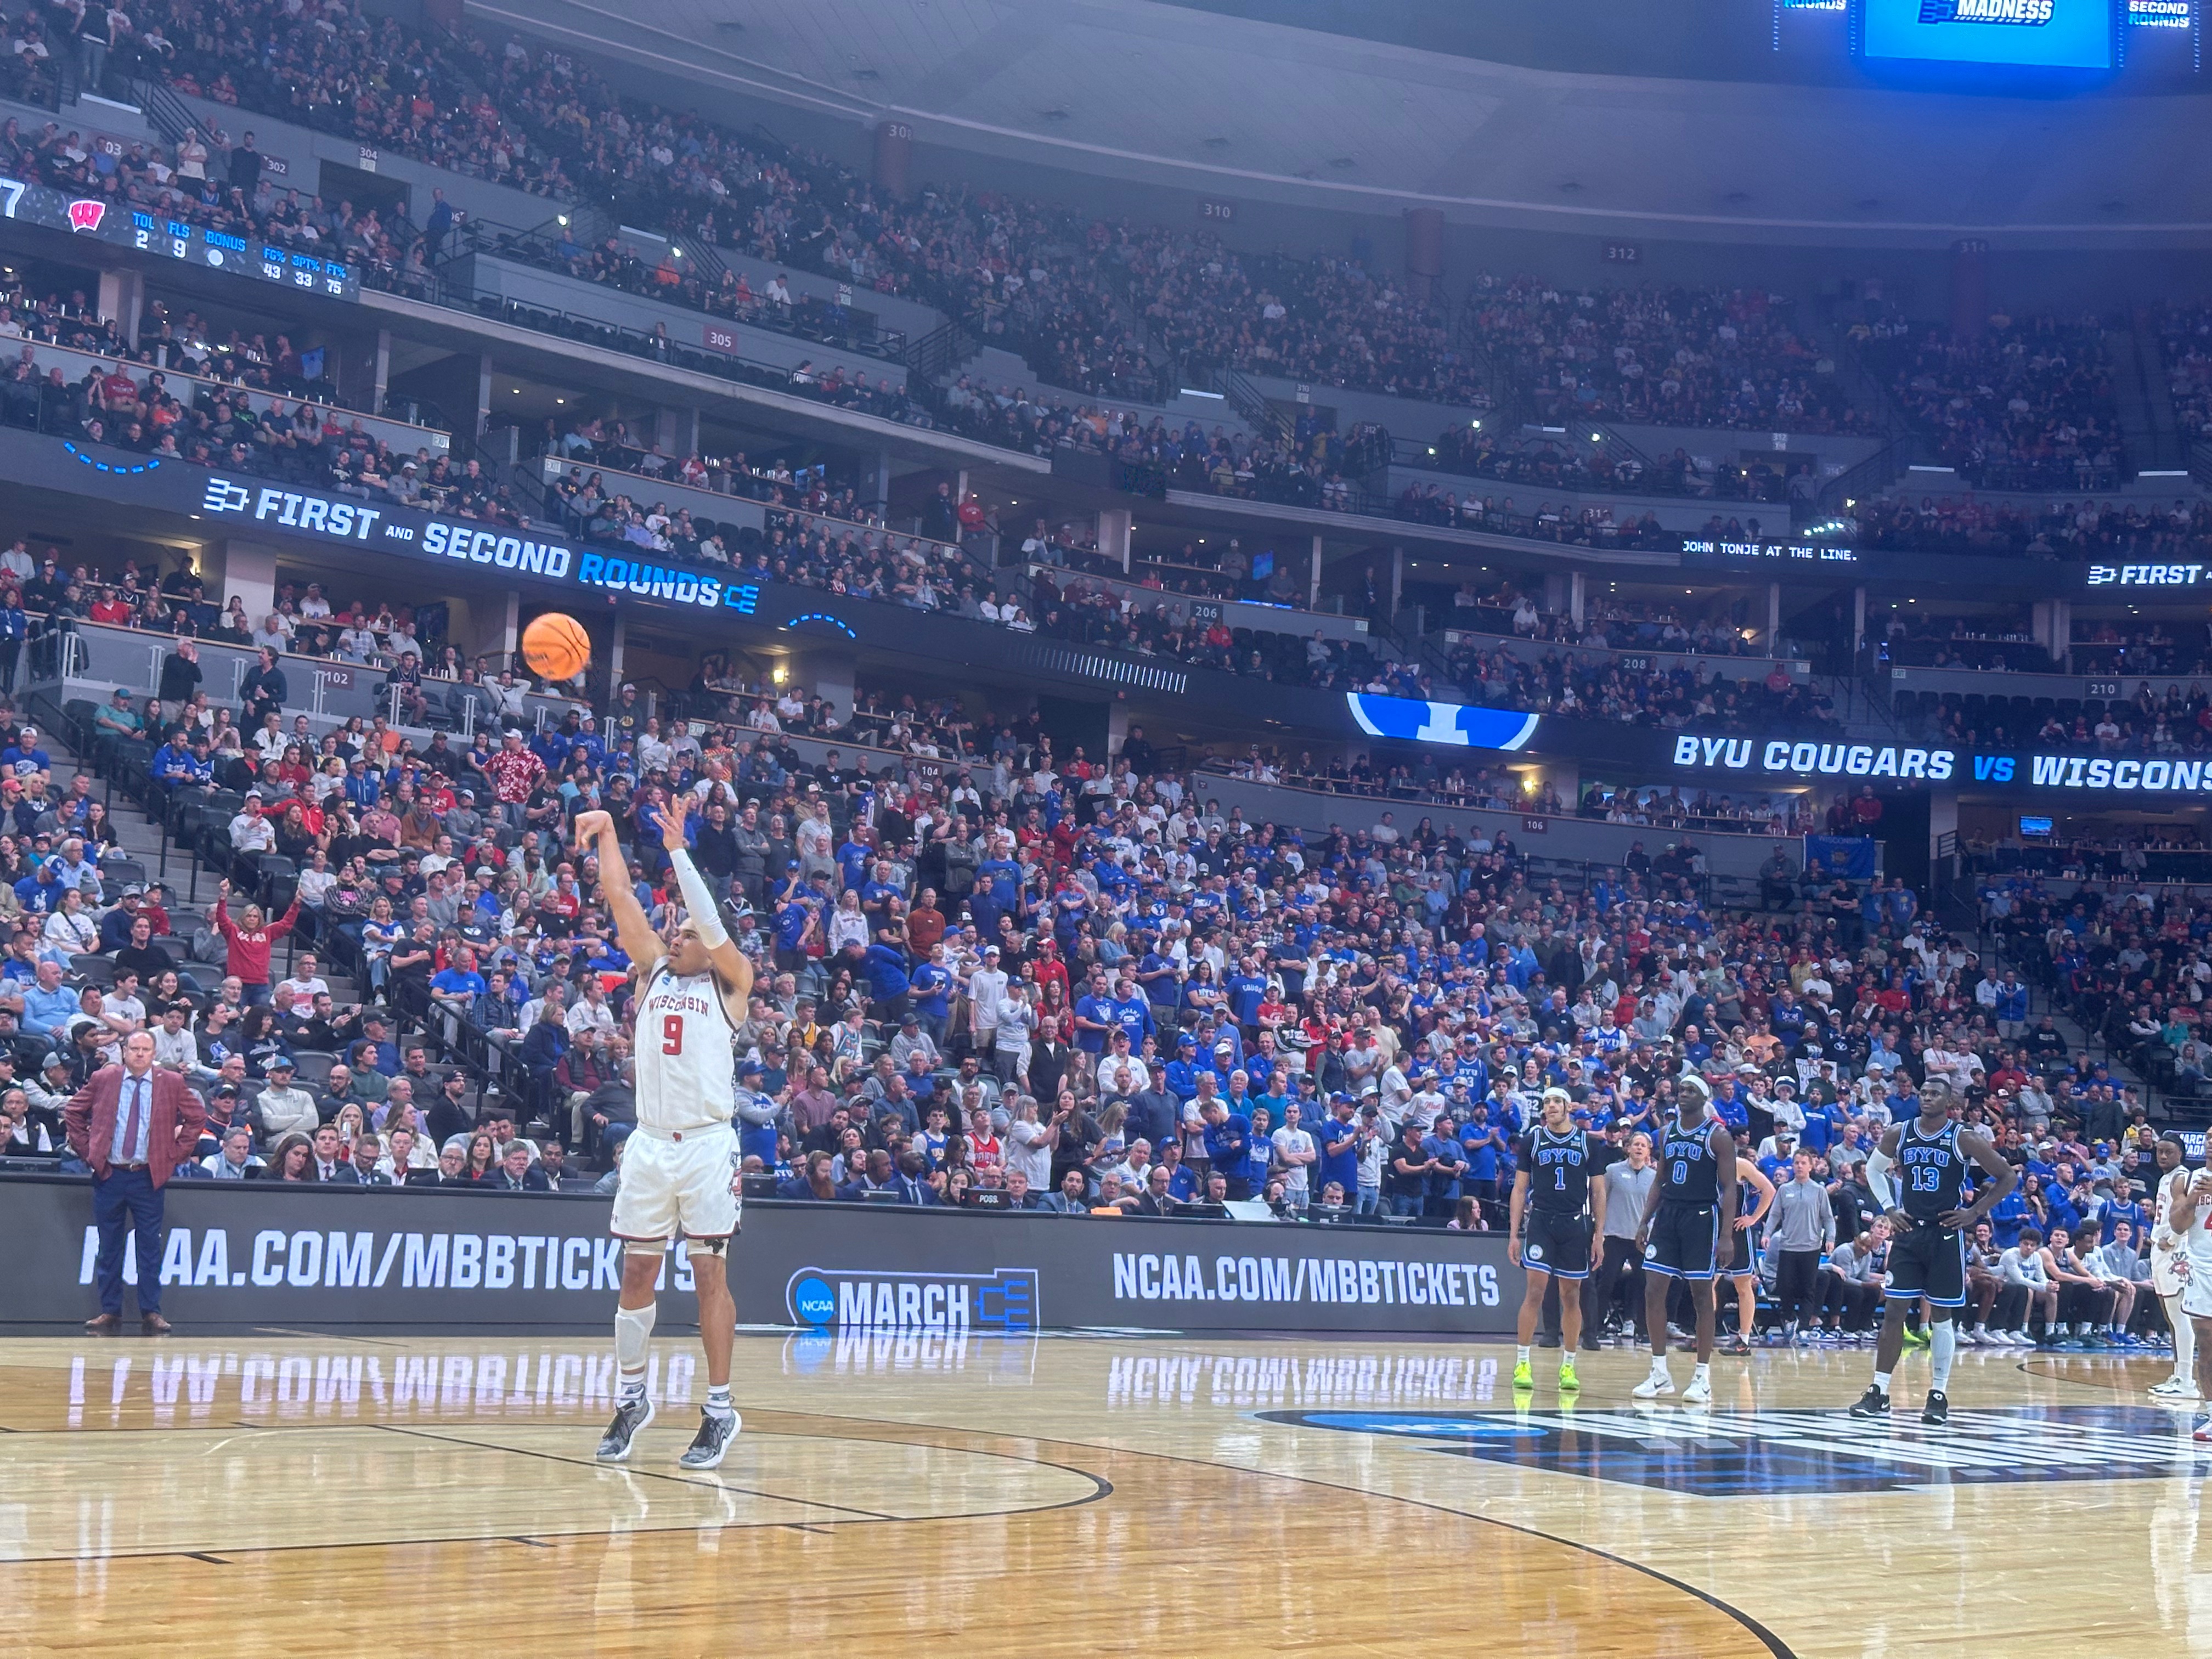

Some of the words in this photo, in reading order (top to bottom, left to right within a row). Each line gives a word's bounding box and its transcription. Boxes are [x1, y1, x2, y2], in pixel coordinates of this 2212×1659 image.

[1957, 0, 2053, 20] MADNESS
[2129, 1, 2188, 15] SECOND
[2129, 14, 2191, 28] ROUNDS
[105, 142, 121, 155] 03
[360, 147, 377, 160] 304
[268, 160, 286, 173] 302
[0, 178, 25, 218] 7
[1205, 204, 1229, 218] 310
[133, 212, 154, 230] TOL
[168, 221, 190, 239] FLS
[136, 230, 148, 249] 2
[173, 239, 187, 258] 9
[205, 229, 246, 252] BONUS
[263, 246, 286, 263] FG%
[291, 253, 320, 272] 3PT%
[326, 262, 347, 278] FT%
[1609, 247, 1634, 259] 312
[263, 263, 281, 280] 43
[295, 271, 313, 287] 33
[326, 278, 342, 295] 75
[839, 284, 852, 295] 306
[710, 332, 731, 348] 305
[1364, 425, 1376, 434] 312
[255, 487, 381, 540] FIRST
[385, 524, 414, 541] AND
[422, 521, 571, 579] SECOND
[578, 552, 722, 607] ROUNDS
[1682, 541, 1714, 553] JOHN
[1720, 543, 1759, 556] TONJE
[1765, 546, 1782, 557] AT
[1788, 547, 1813, 558] THE
[1820, 549, 1858, 561] LINE.
[2119, 565, 2203, 585] FIRST
[1196, 606, 1217, 618] 206
[1624, 658, 1646, 669] 208
[326, 671, 348, 685] 102
[2091, 684, 2115, 695] 210
[690, 724, 704, 735] EXIT
[1673, 735, 1752, 769] BYU
[1763, 741, 1955, 780] COUGARS
[1974, 755, 2015, 782] VS
[922, 766, 938, 776] 104
[1527, 821, 1543, 830] 106
[1818, 835, 1863, 844] WISCONSIN
[648, 995, 709, 1017] WISCONSIN
[662, 1014, 684, 1056] 9
[1458, 1068, 1478, 1076] BYU
[1538, 1148, 1582, 1166] BYU
[1665, 1141, 1703, 1161] BYU
[1903, 1146, 1950, 1167] BYU
[1555, 1166, 1566, 1190] 1
[1672, 1160, 1688, 1184] 0
[1911, 1165, 1940, 1192] 13
[979, 1194, 999, 1203] POSS.
[1113, 1252, 1500, 1307] NCAA.COM/MBBTICKETS
[802, 1300, 834, 1312] NCAA
[839, 1282, 970, 1325] MARCH
